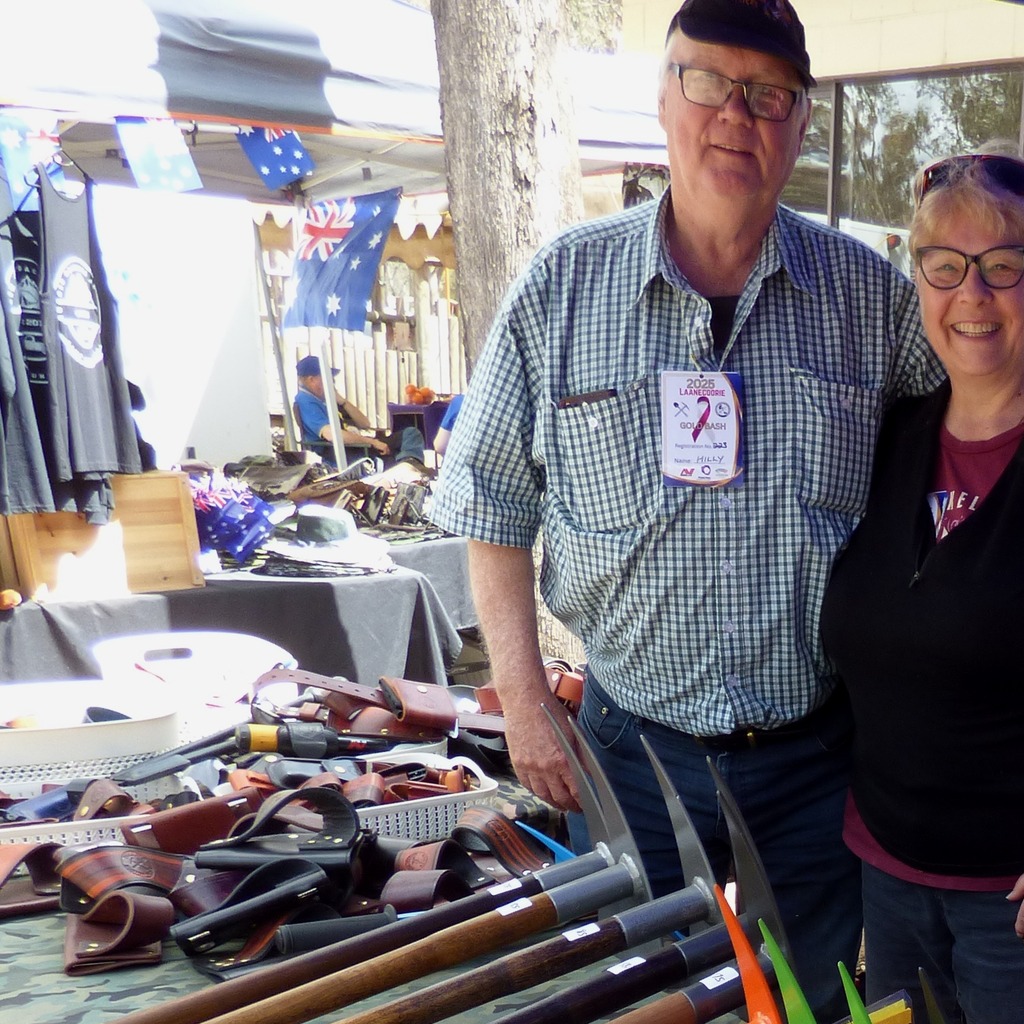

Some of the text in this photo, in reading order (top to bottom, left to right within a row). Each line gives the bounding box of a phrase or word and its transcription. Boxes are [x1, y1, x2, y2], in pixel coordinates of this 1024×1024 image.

[686, 378, 716, 389] 2025
[679, 387, 726, 397] LAANECOORIE
[680, 421, 727, 431] GOLD BASH
